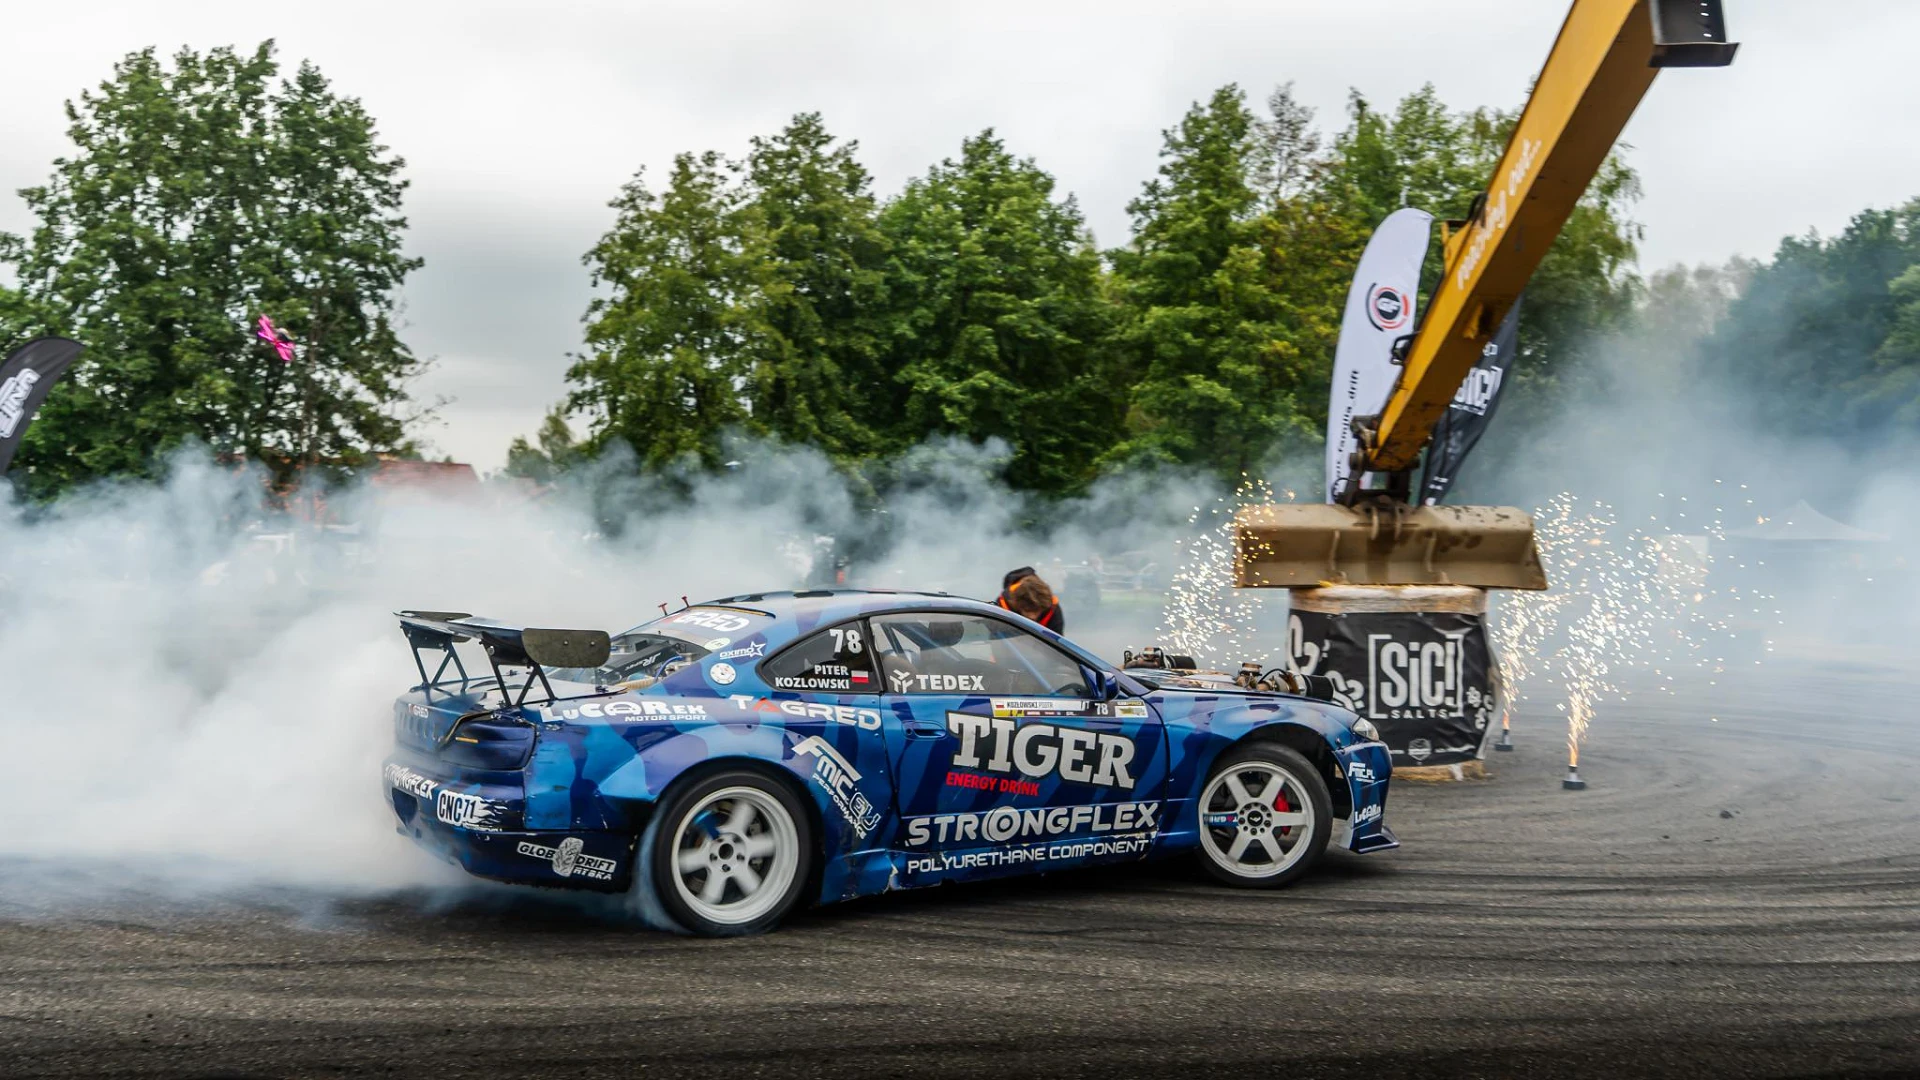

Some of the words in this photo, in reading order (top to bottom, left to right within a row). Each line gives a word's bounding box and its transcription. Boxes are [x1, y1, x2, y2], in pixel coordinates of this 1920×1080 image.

[828, 628, 863, 654] 78
[814, 664, 849, 676] PITER
[915, 674, 986, 691] TEDEX
[775, 677, 850, 690] KOZLOWSKI
[729, 694, 882, 731] TAGRED
[1094, 702, 1109, 716] 78
[1390, 709, 1450, 720] SALTS
[946, 713, 1136, 789] TIGER
[946, 772, 998, 792] ENERGY
[999, 778, 1041, 798] DRINK
[439, 793, 477, 823] CNC71
[812, 772, 867, 840] PERFORMANCE
[905, 803, 1159, 847] STRONGFLEX
[575, 855, 615, 871] DRIFT
[907, 846, 1046, 875] POLYURETHANE
[1049, 839, 1150, 864] COMPONENT
